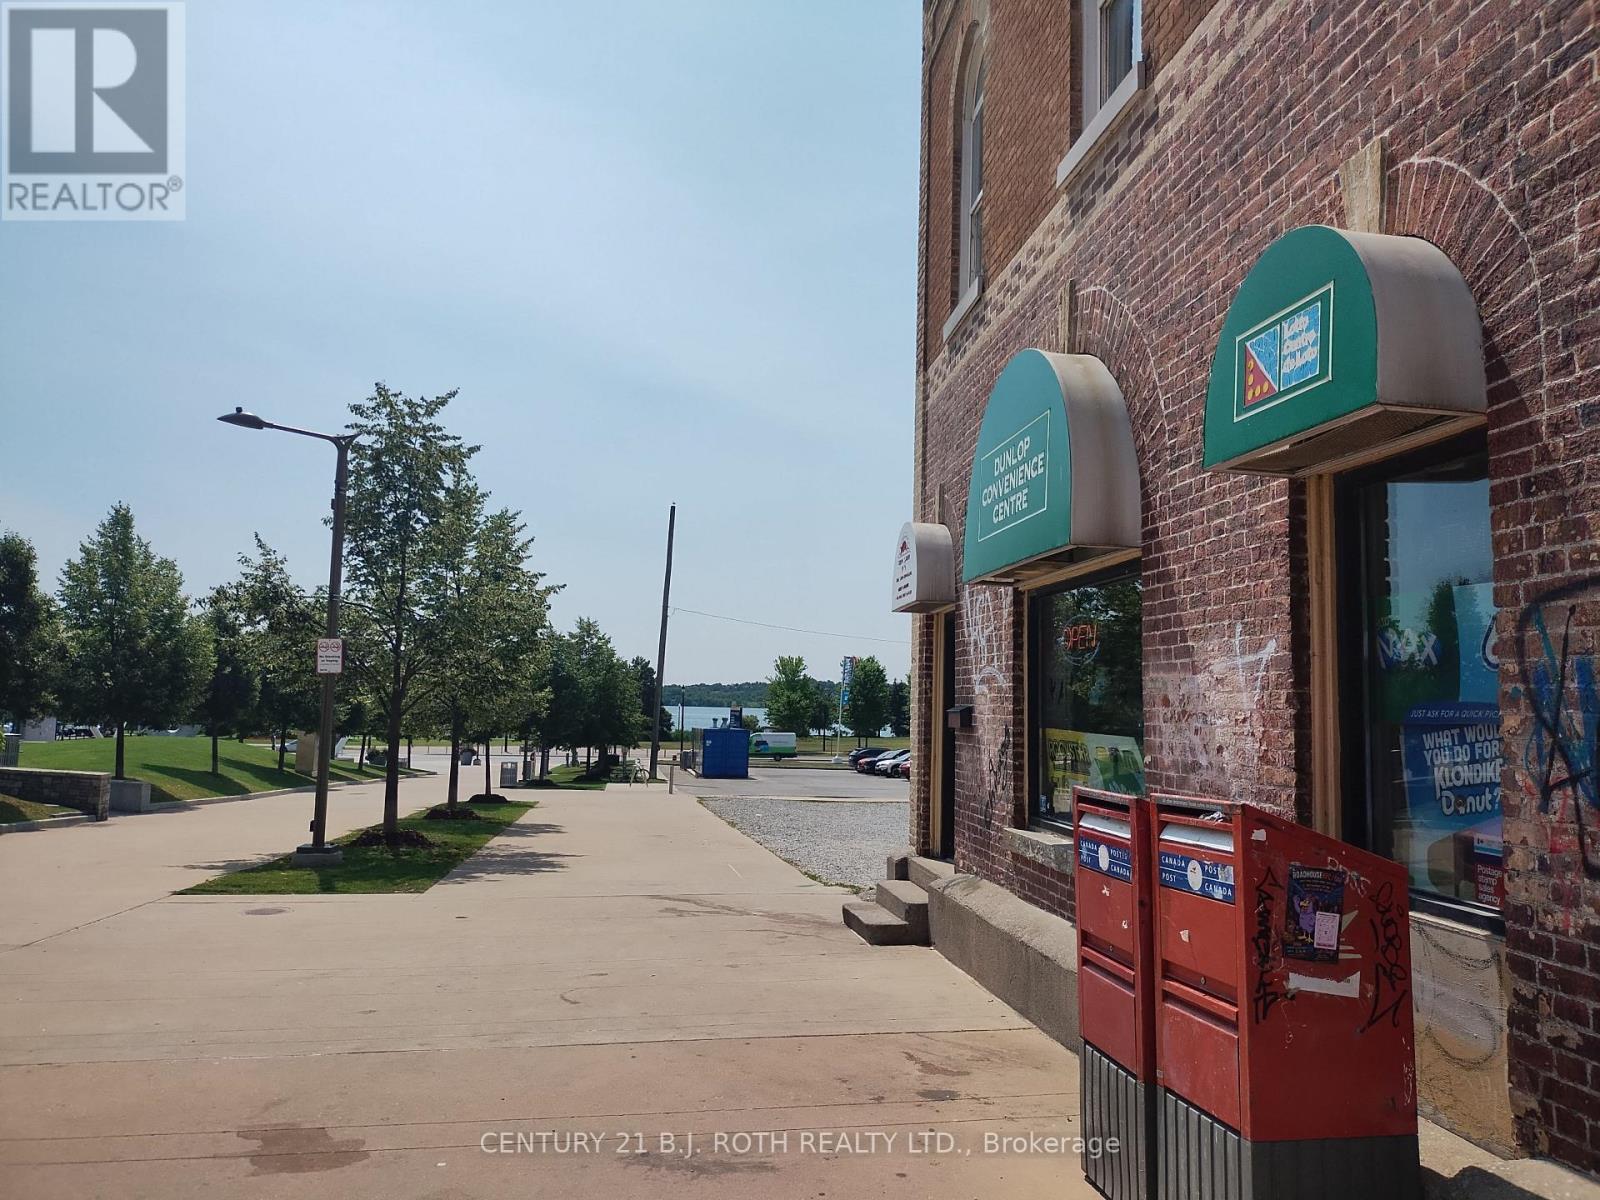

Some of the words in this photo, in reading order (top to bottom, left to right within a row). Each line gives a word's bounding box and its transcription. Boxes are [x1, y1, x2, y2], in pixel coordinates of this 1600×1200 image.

[994, 436, 1031, 477] DUNLOP
[982, 452, 1045, 507] CONVENIENCE
[992, 488, 1029, 524] CENTRE
[1064, 624, 1097, 650] OPEN
[1410, 710, 1426, 718] JUST
[1427, 710, 1439, 718] ASK
[1440, 710, 1454, 718] FOR
[1461, 710, 1483, 718] QUICK
[1422, 728, 1460, 750] WHAT
[1464, 723, 1503, 743] WOUL
[1424, 748, 1450, 766] YOU
[1453, 744, 1471, 762] DO
[1474, 740, 1501, 760] FOR
[1080, 840, 1098, 851] CANADA
[1161, 855, 1186, 868] CANADA
[1111, 865, 1130, 876] CANADA
[1204, 865, 1221, 875] POST
[1477, 864, 1503, 877] Postage
[1162, 872, 1176, 882] POST
[1478, 875, 1498, 886] stamp
[1204, 882, 1232, 897] CANADA
[1478, 893, 1501, 905] agency
